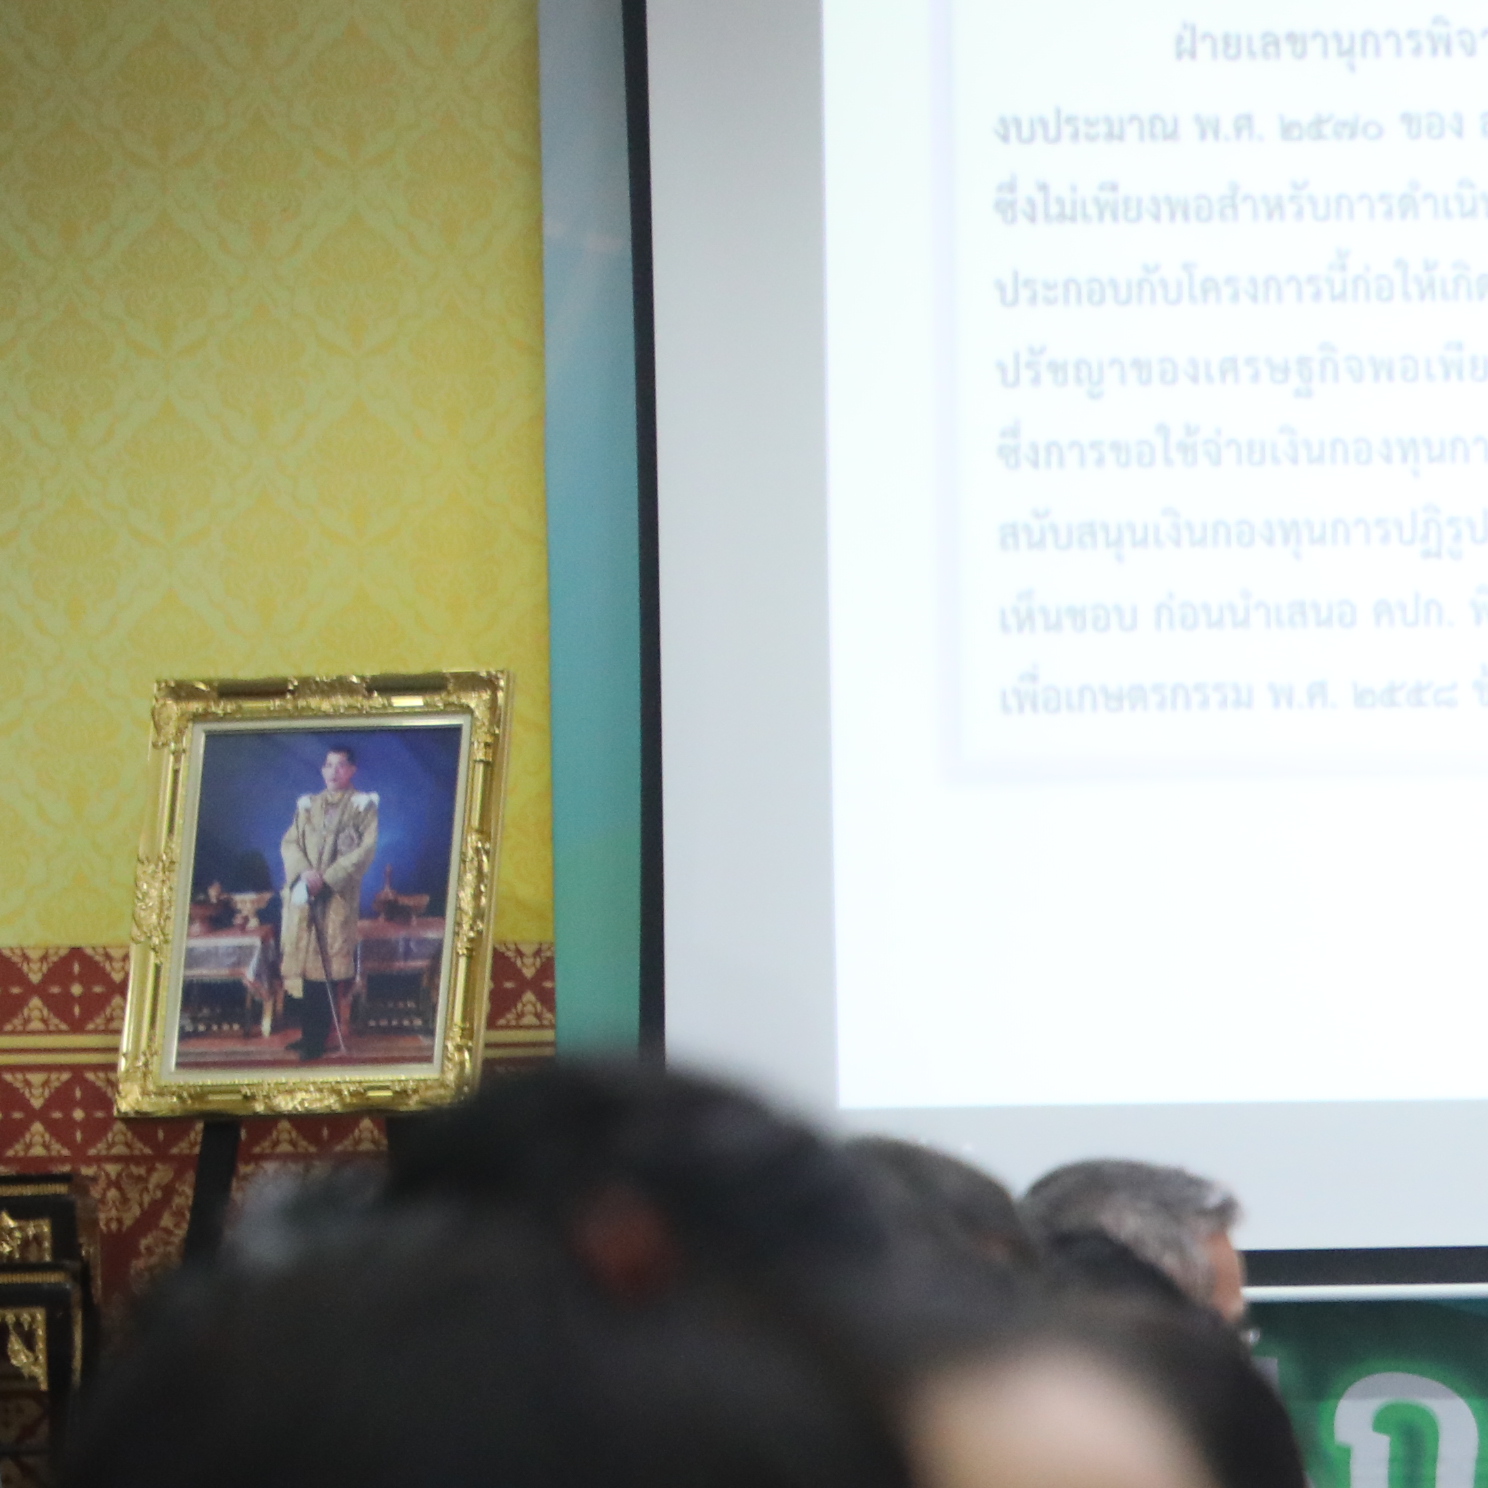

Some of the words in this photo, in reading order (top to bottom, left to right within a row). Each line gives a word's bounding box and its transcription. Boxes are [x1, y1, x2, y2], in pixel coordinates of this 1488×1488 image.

[1193, 111, 1263, 141] พ.ศ.
[1279, 113, 1384, 141] ๒๕๗๐
[1399, 109, 1464, 140] ของ
[999, 587, 1138, 633] เห็นชอบ
[1372, 592, 1453, 627] คปก.
[1267, 678, 1338, 710] พ.ศ.
